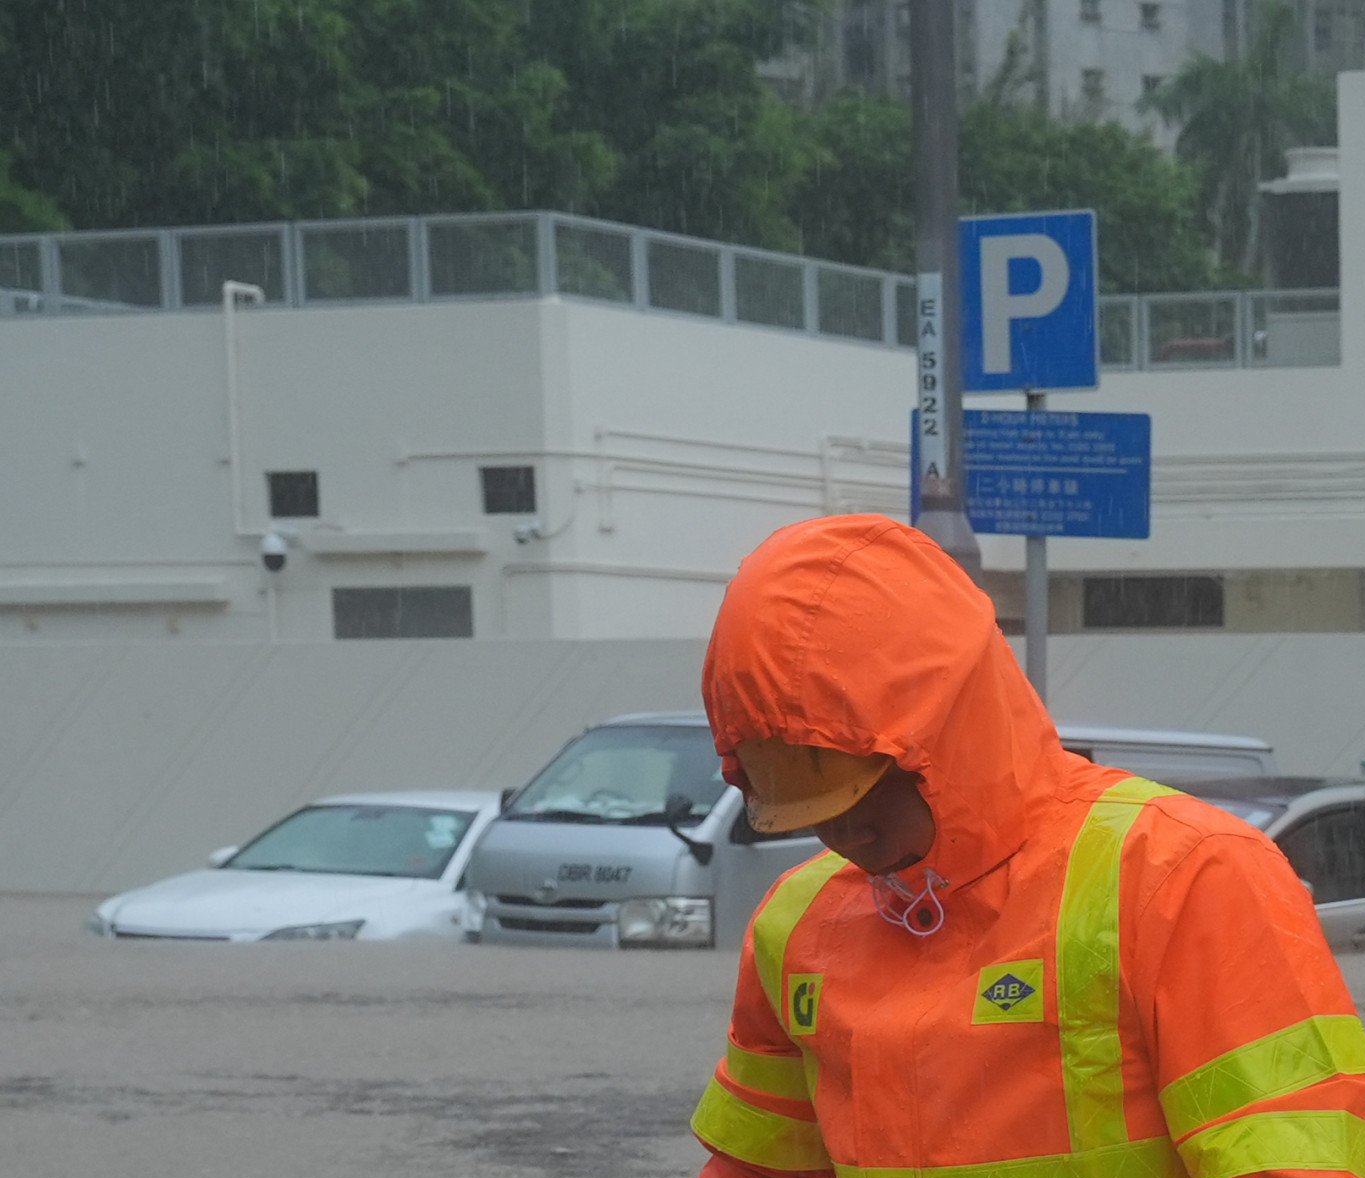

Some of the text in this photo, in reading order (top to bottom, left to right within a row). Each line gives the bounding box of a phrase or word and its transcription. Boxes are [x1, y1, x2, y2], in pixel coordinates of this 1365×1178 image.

[920, 300, 936, 337] EA
[981, 233, 1070, 375] P
[993, 983, 1021, 998] RB
